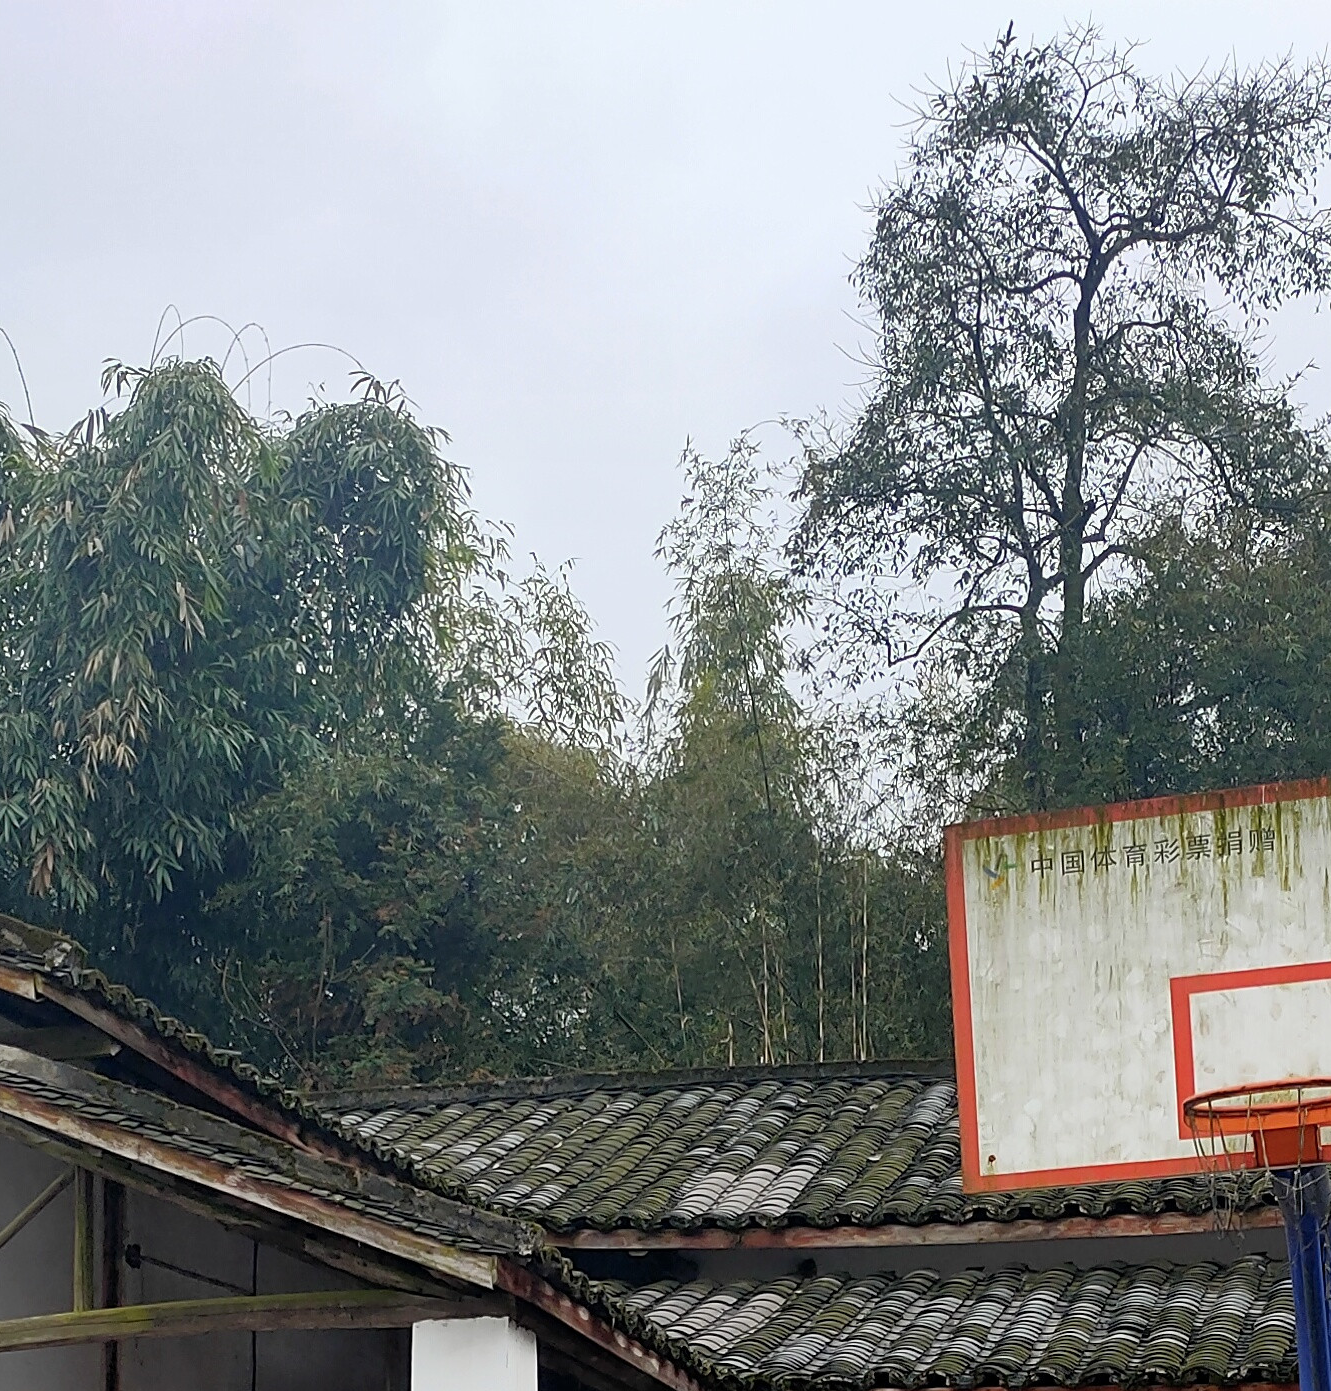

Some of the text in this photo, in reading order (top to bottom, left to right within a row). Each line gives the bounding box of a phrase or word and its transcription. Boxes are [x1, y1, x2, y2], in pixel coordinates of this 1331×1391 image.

[1030, 829, 1276, 880] 中国体育彩票捐赠
